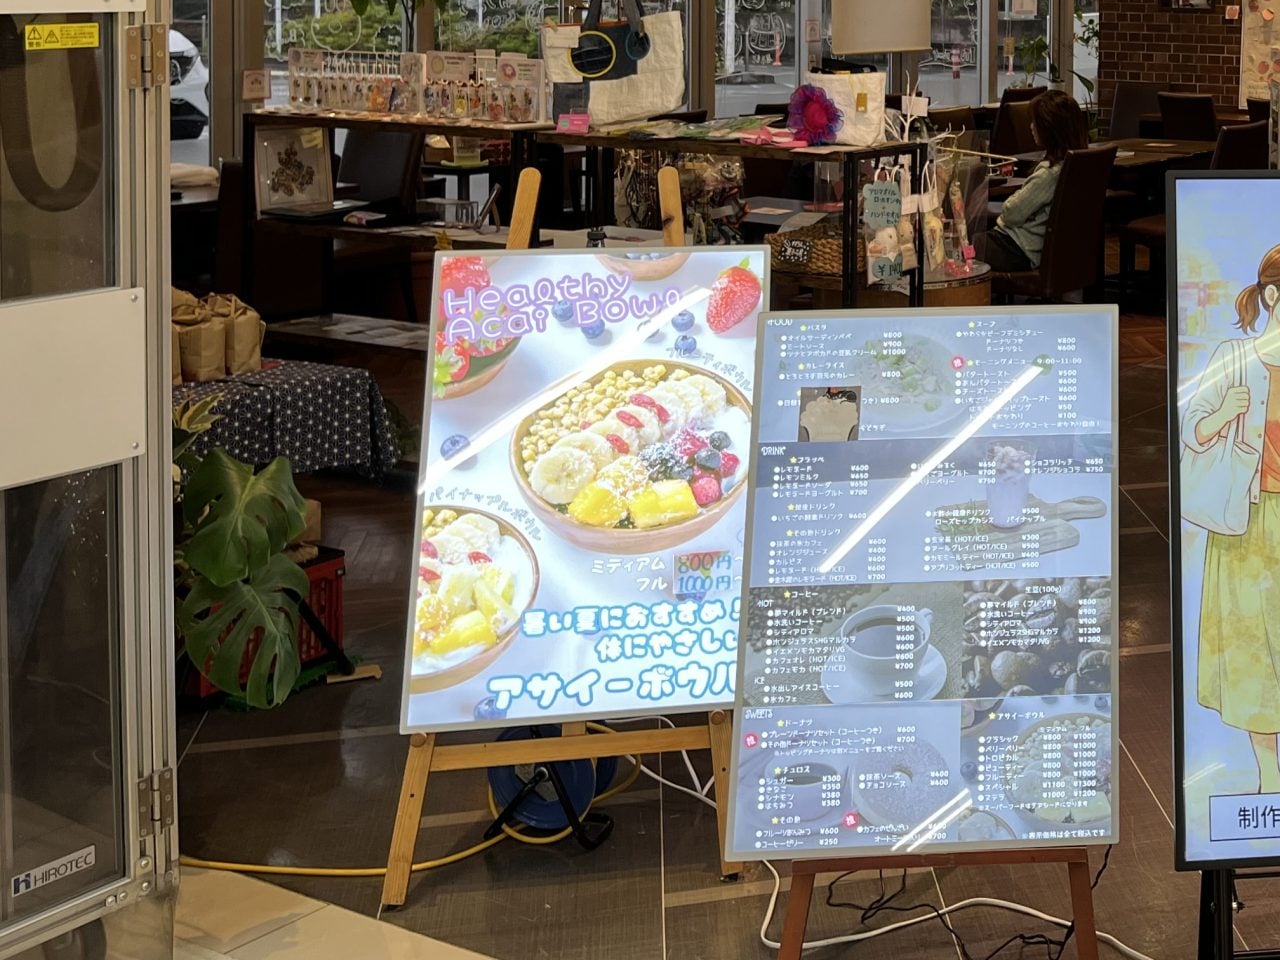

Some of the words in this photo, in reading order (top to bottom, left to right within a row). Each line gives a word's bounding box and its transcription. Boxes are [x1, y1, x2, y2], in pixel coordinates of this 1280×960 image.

[444, 272, 632, 317] Healthy
[446, 308, 550, 344] Acai
[761, 446, 786, 456] DRINK
[591, 556, 666, 573] ミディアム
[637, 578, 668, 591] フル
[782, 766, 810, 774] チュロス
[33, 852, 93, 888] HIROTEC
